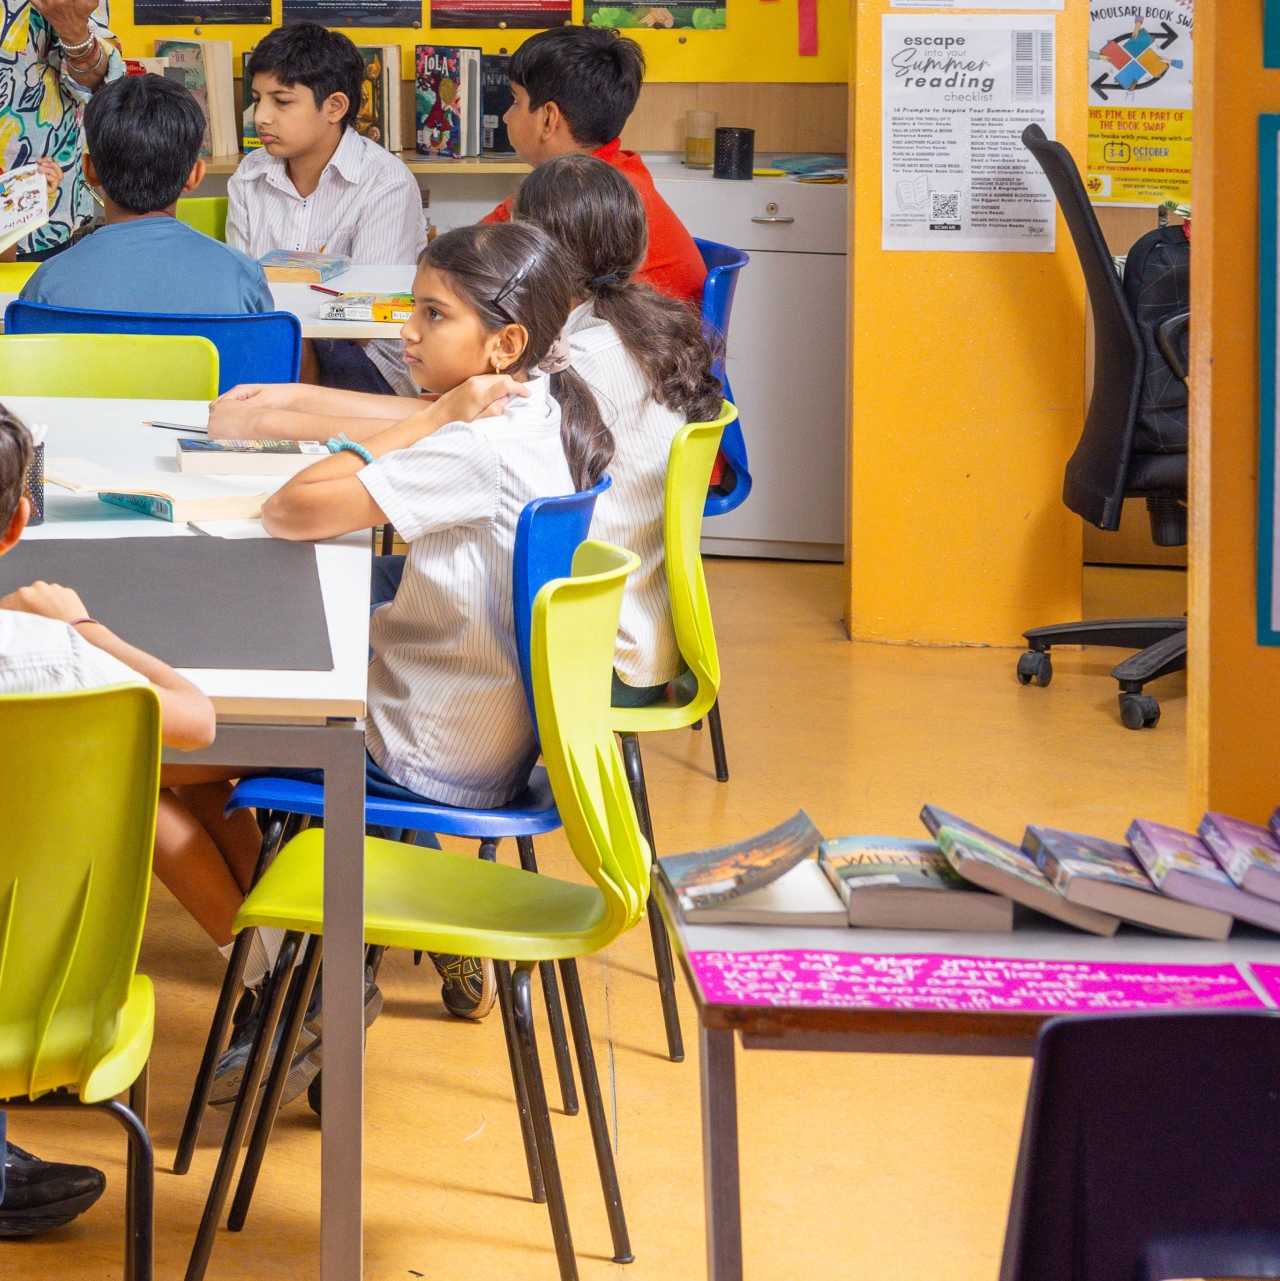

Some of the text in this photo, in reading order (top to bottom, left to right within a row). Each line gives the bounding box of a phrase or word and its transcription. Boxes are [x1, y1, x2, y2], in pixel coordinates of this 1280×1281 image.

[1091, 6, 1173, 21] MOULSARI BOOK
[904, 37, 965, 49] escape
[946, 50, 966, 59] your
[425, 55, 449, 77] LOLA
[891, 48, 991, 77] Summer
[905, 72, 994, 92] reading
[944, 92, 993, 101] checklist
[1089, 110, 1184, 121] HIS PTM, BE A PART OF
[1100, 121, 1165, 131] THE BOOK SWAP
[1110, 147, 1169, 158] 3-4 OCTOBER
